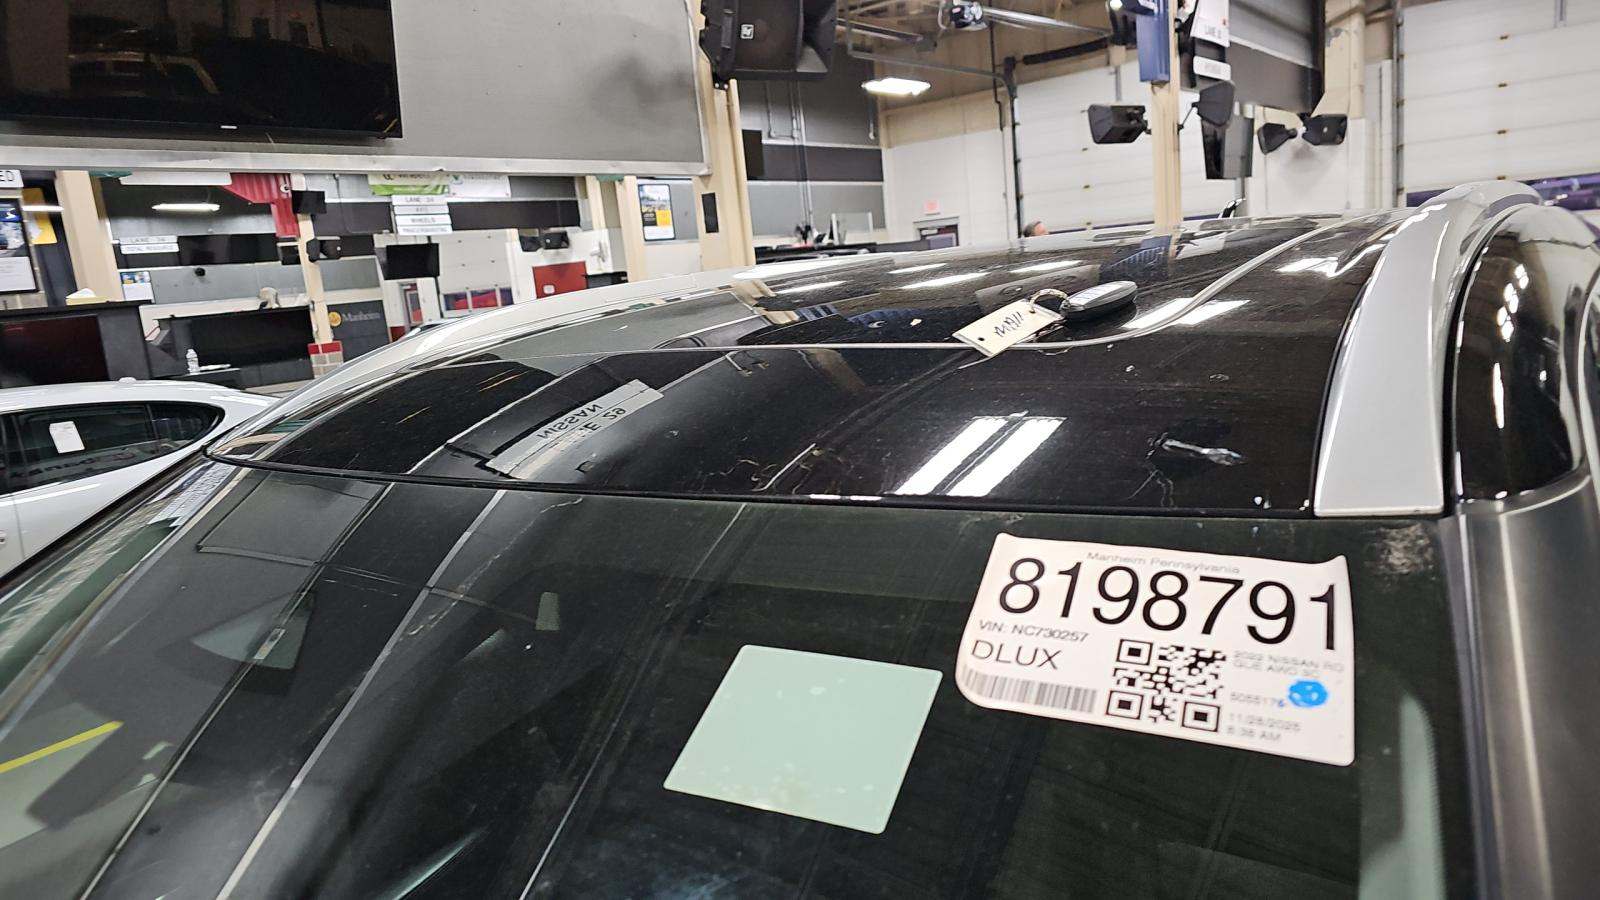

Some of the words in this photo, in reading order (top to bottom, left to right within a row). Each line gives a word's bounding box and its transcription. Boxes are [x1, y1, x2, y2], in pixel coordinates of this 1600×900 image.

[1087, 552, 1146, 566] Manheim
[1150, 557, 1240, 574] Pennsylvania
[999, 557, 1337, 651] 8198791
[979, 619, 1008, 635] VIN:
[1012, 623, 1089, 643] NC730257
[970, 639, 1062, 670] DLUX
[1268, 654, 1319, 668] NISSAN
